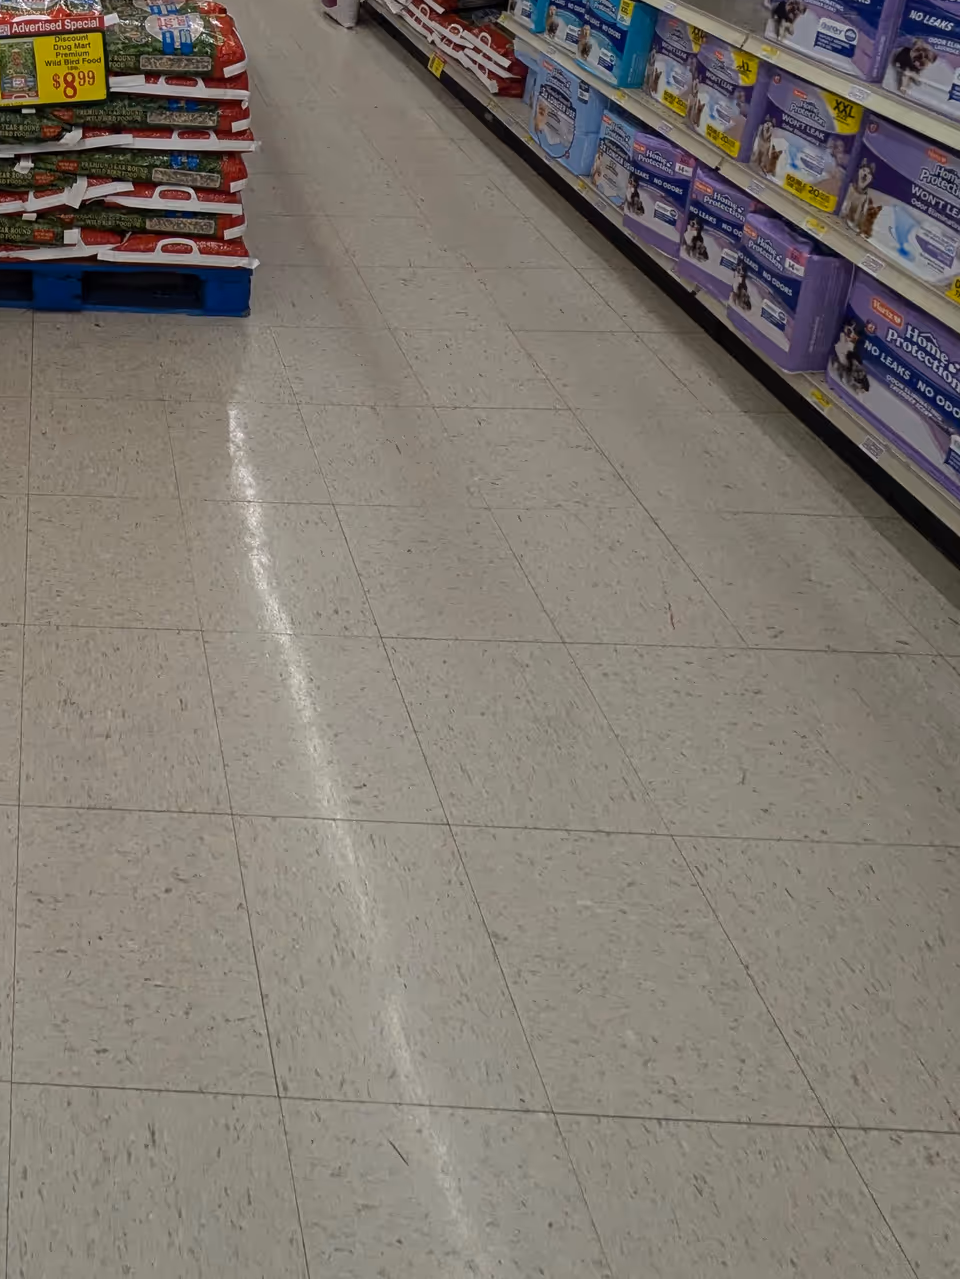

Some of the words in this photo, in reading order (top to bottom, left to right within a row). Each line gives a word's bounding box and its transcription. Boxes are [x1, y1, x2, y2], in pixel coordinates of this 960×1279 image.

[12, 20, 62, 34] Advertised
[64, 18, 99, 31] Special
[909, 10, 923, 21] NO
[923, 15, 955, 32] LEAKS
[53, 44, 71, 52] Drug
[54, 34, 89, 42] Discount
[44, 59, 61, 67] Wild
[55, 50, 90, 58] Premium
[547, 91, 567, 113] LONGER
[566, 105, 576, 118] USE
[833, 99, 855, 119] XXL
[782, 113, 806, 130] WON'T
[805, 126, 825, 140] LEAK
[790, 104, 826, 128] Protection
[638, 154, 674, 176] Protection
[646, 149, 667, 166] Home
[653, 177, 663, 186] NO
[663, 181, 684, 195] ODORS
[808, 185, 820, 198] 20
[714, 192, 738, 210] Home
[911, 184, 945, 210] WON'T
[911, 198, 927, 210] Odor
[689, 205, 698, 215] NO
[698, 210, 717, 225] LEAKS
[721, 223, 732, 232] NO
[703, 195, 746, 222] Protection
[748, 239, 783, 272] Protection
[757, 236, 777, 256] Home
[762, 270, 772, 281] NO
[772, 277, 793, 297] ODORS
[905, 324, 948, 365] Home
[864, 339, 880, 356] NO
[880, 351, 912, 381] LEAKS
[916, 377, 934, 398] NO
